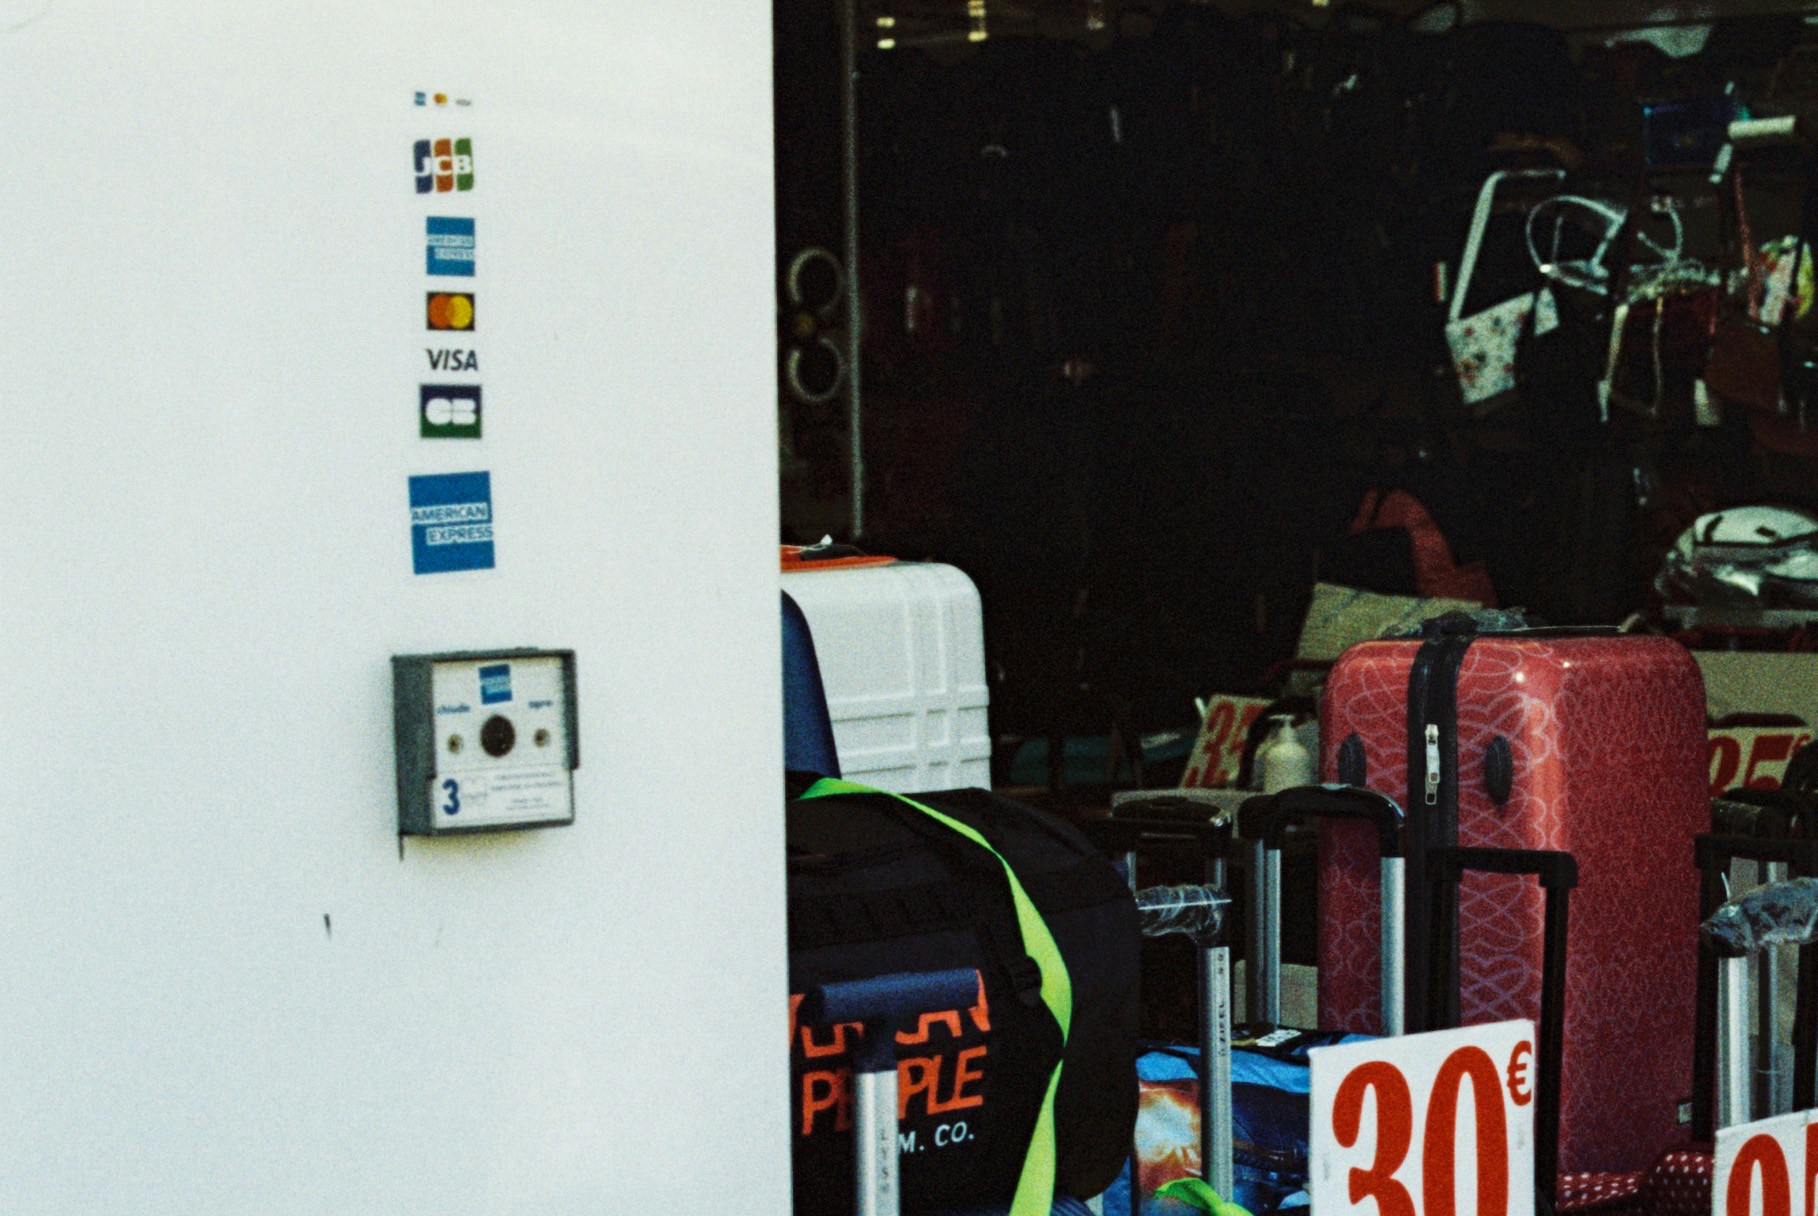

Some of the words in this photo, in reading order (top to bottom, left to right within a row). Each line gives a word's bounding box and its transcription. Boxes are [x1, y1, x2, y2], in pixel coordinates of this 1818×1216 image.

[427, 349, 478, 371] VISA
[412, 503, 487, 523] AMERICAN
[428, 527, 493, 543] EXPRESS
[442, 778, 461, 815] 3
[802, 1046, 986, 1134] PPLE
